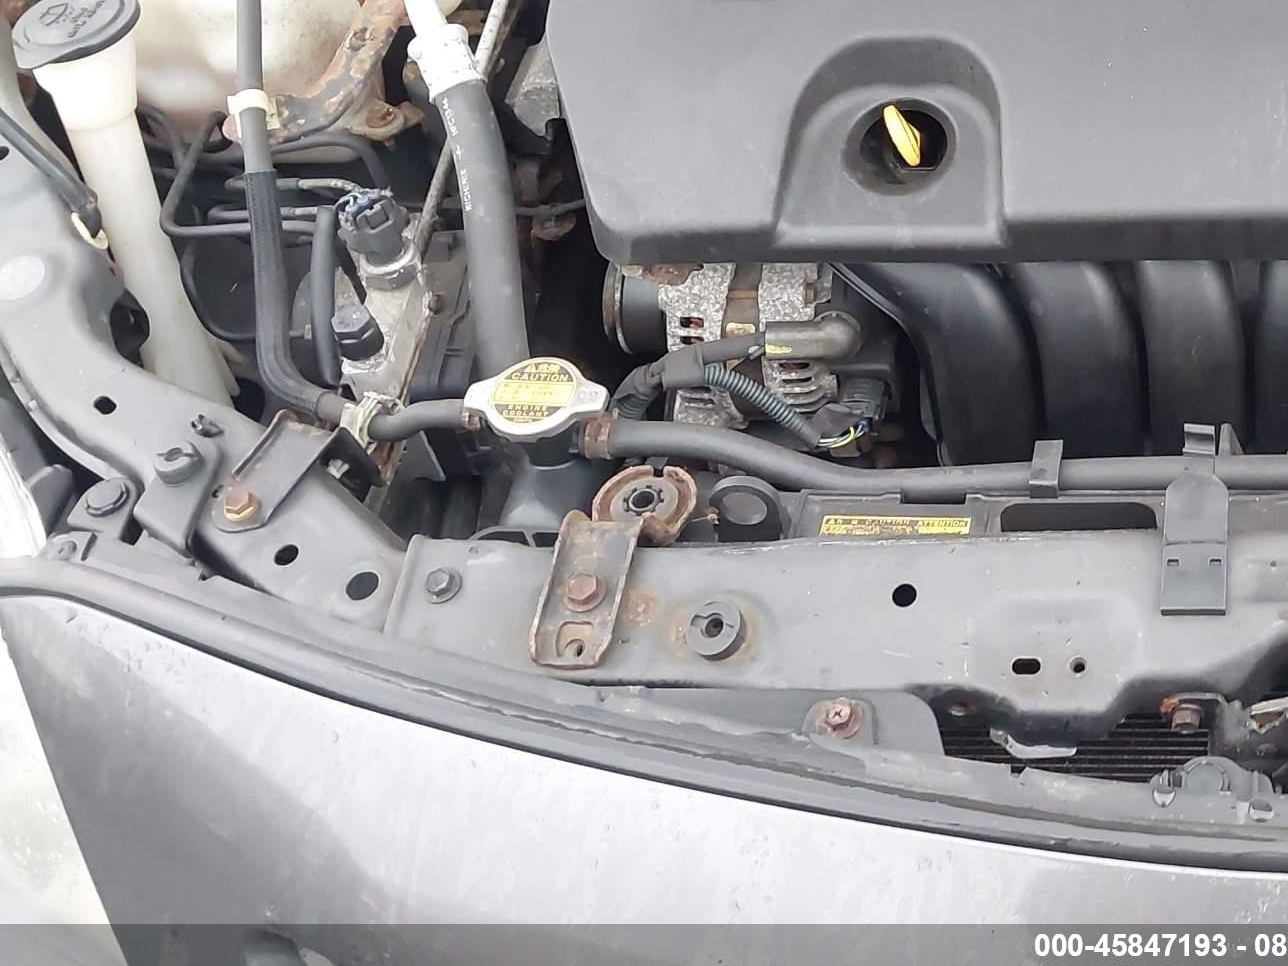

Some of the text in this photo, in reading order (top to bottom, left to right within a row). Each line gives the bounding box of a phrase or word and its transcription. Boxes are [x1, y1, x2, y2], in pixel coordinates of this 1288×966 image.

[511, 373, 569, 382] CAUTION
[502, 409, 550, 417] COOLANT
[916, 520, 967, 528] ATTENTION
